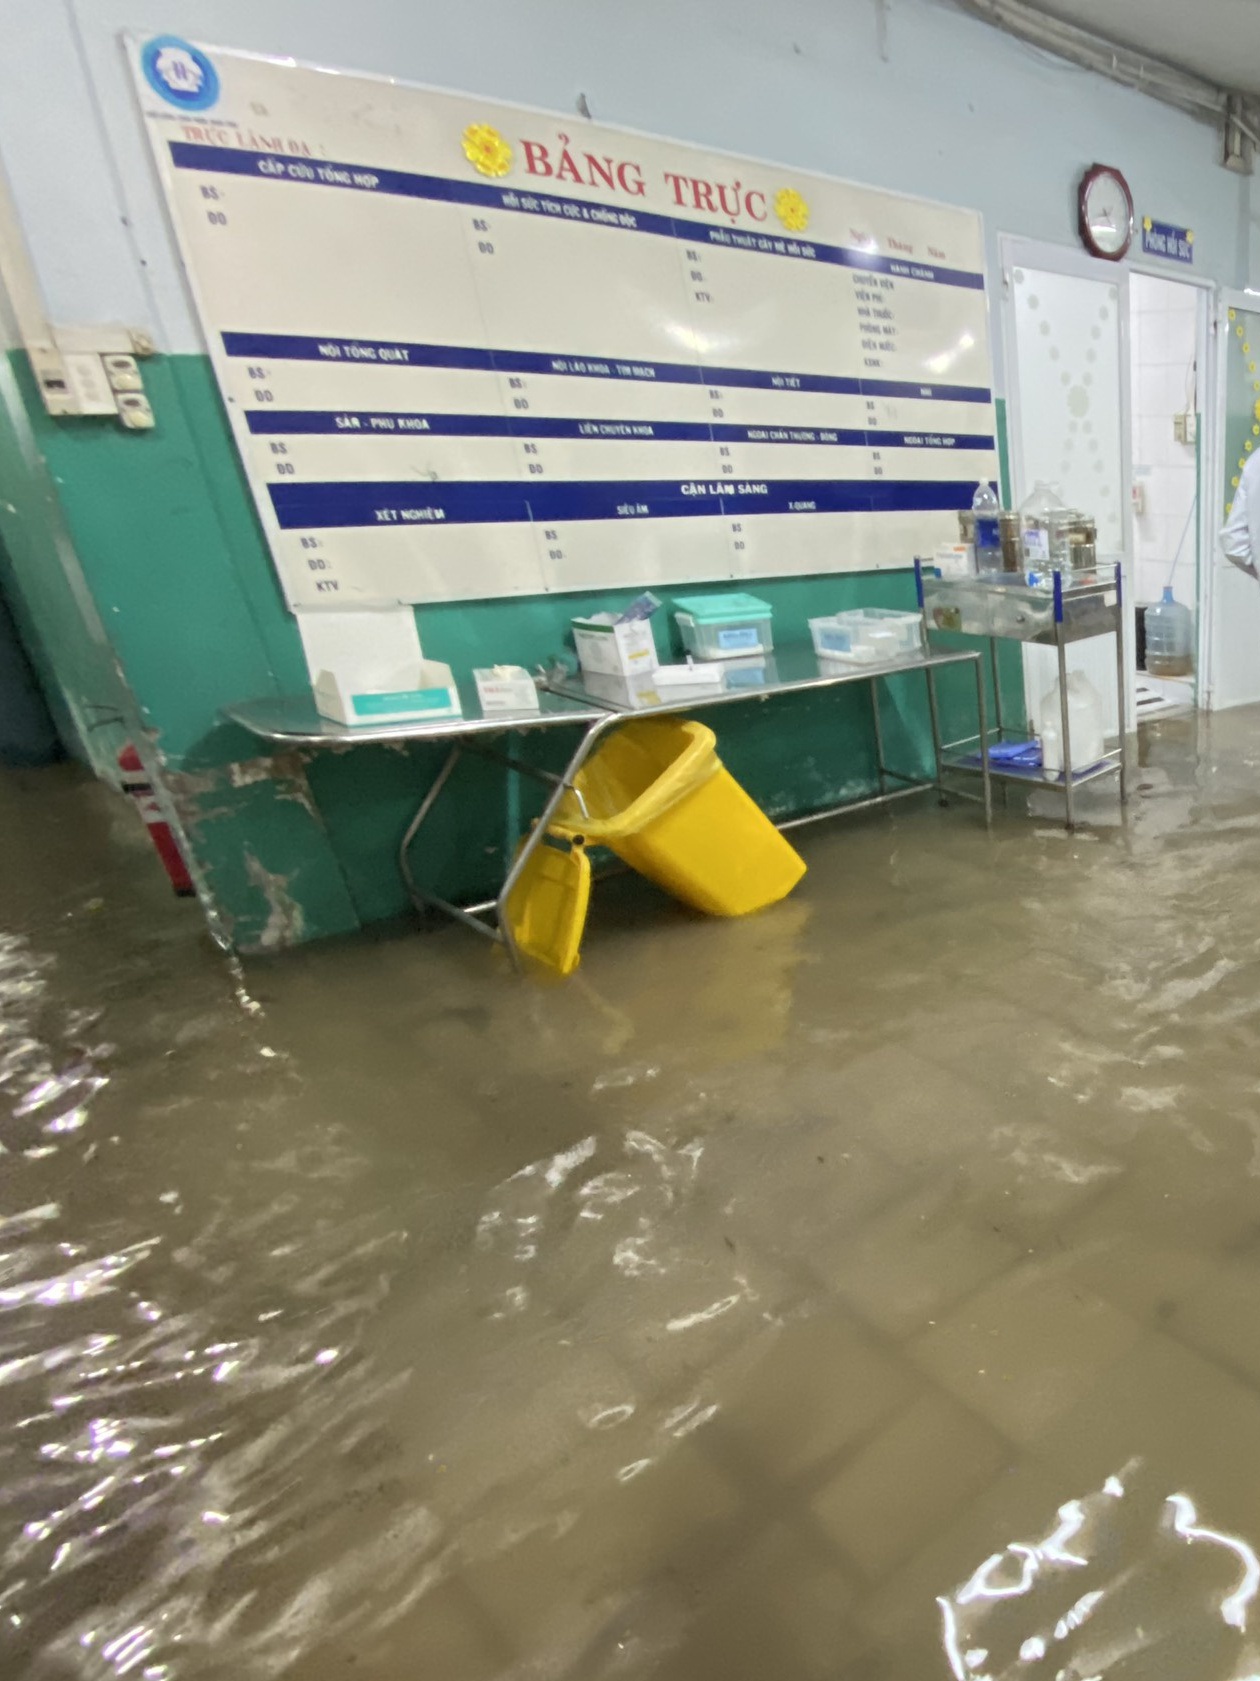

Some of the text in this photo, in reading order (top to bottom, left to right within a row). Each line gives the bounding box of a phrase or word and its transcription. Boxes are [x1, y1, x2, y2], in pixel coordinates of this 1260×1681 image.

[257, 158, 286, 175] CẤP
[317, 163, 352, 184] TỔNG
[519, 132, 768, 224] BẢNG TRỰC
[317, 343, 342, 358] NỘI
[343, 342, 377, 360] TỔNG
[616, 364, 632, 377] TIM
[397, 418, 431, 430] KHOA
[680, 481, 768, 497] CẬN LÂM SÀNG
[374, 507, 398, 521] XÉT
[316, 580, 339, 592] KTV
